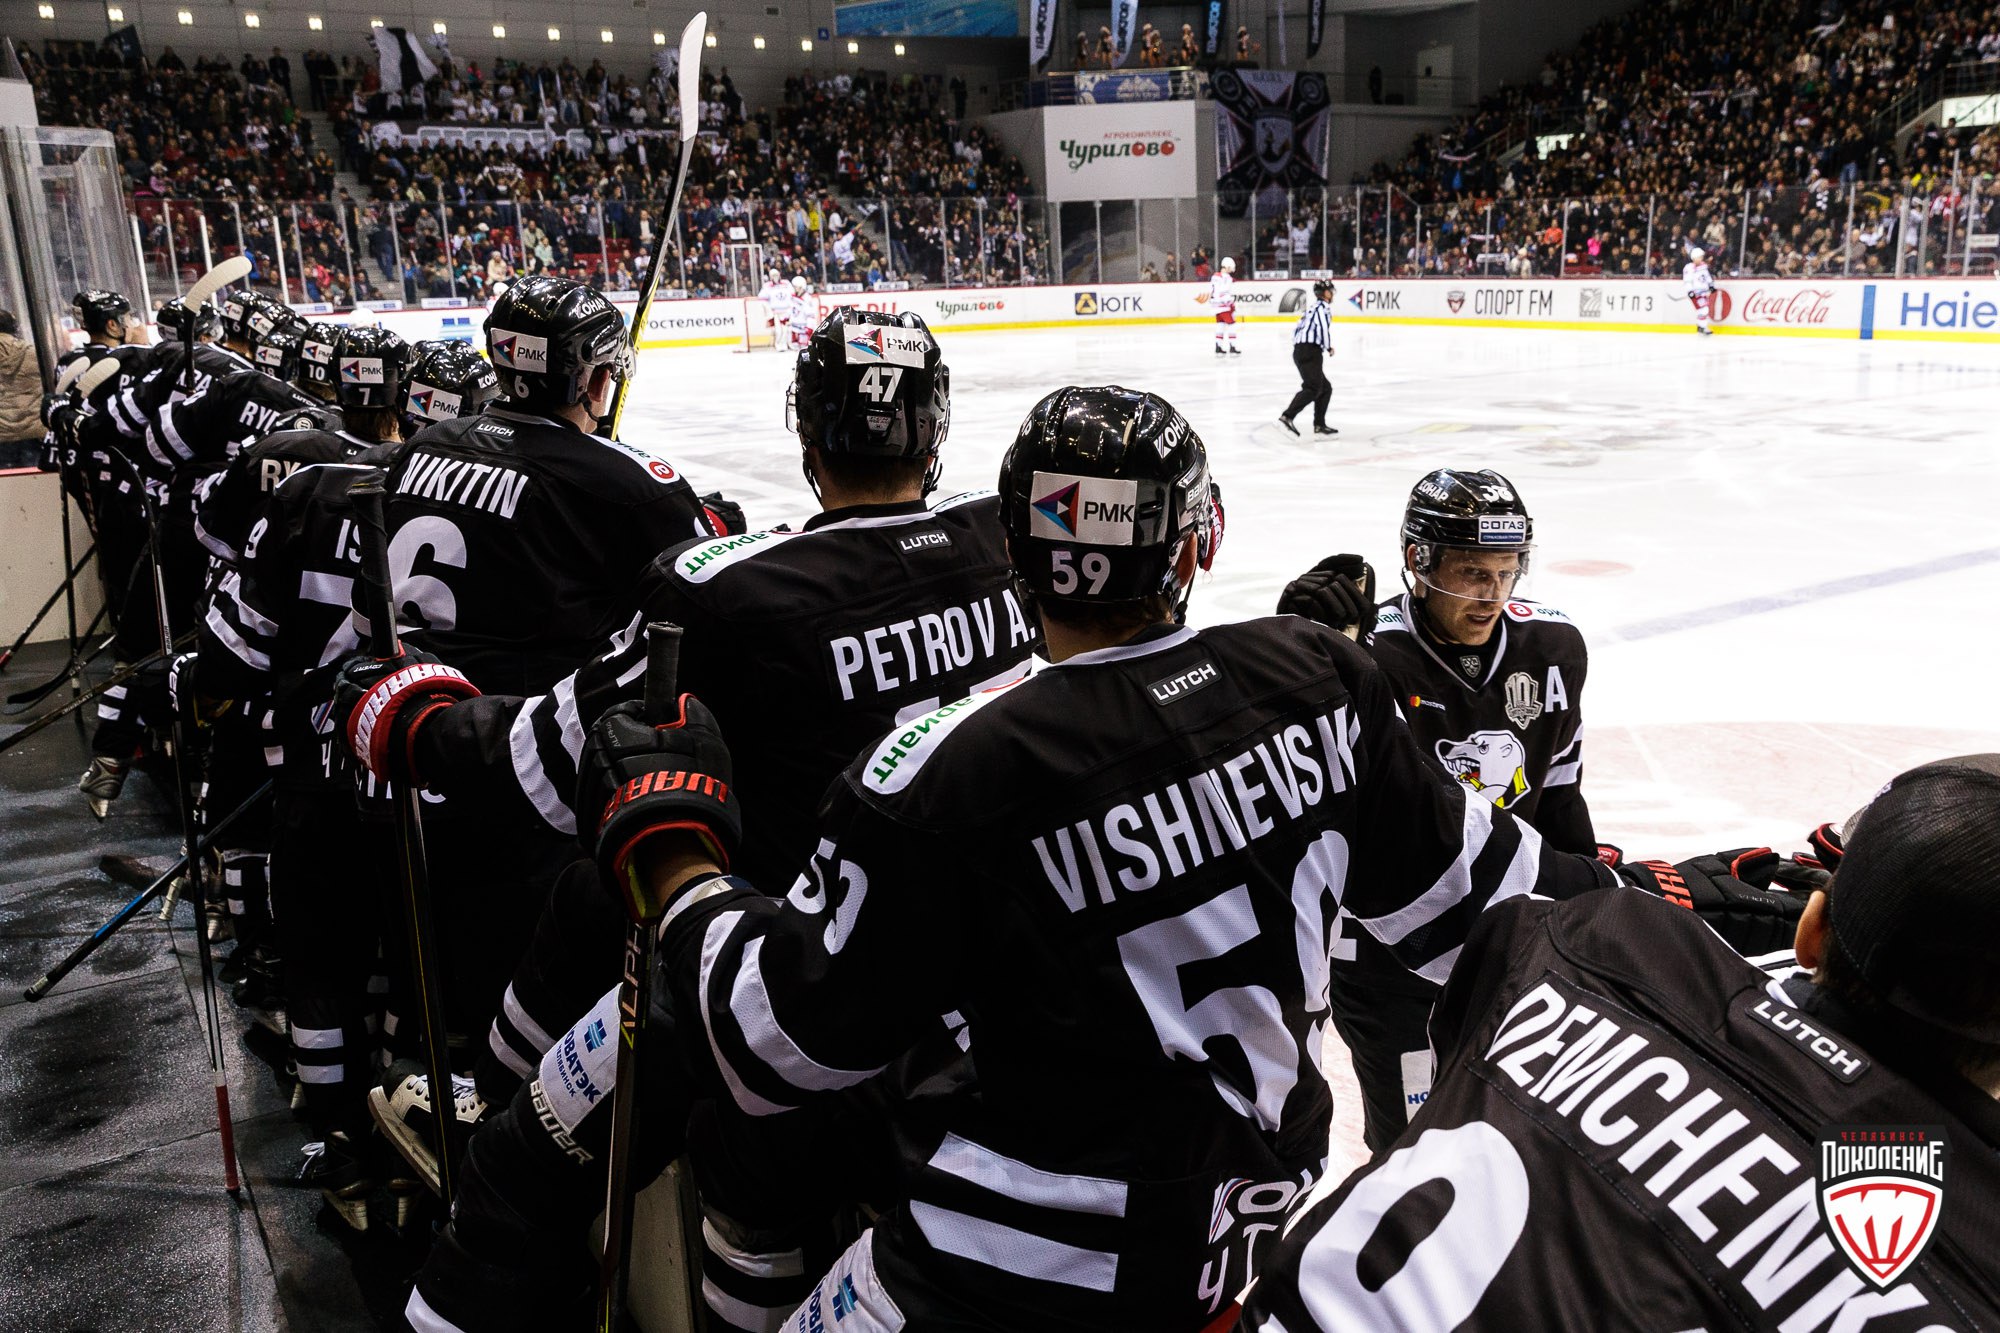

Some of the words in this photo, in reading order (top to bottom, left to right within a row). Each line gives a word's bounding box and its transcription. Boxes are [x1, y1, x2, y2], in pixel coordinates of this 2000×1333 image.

[1103, 129, 1173, 140] АГРОКОМПЛЕКС
[1059, 139, 1176, 172] Чурилово
[935, 300, 1005, 319] Чурилово
[1101, 295, 1143, 313] ЮГК
[1366, 291, 1401, 311] РМК
[1475, 289, 1525, 315] СПОРТ
[1528, 289, 1553, 316] FM
[646, 316, 735, 331] остелеком
[516, 346, 547, 363] РМК
[308, 364, 326, 381] 10
[361, 366, 382, 376] РМК
[514, 374, 530, 399] 6
[858, 365, 904, 403] 47
[358, 387, 371, 406] 7
[432, 400, 459, 415] РМК
[477, 422, 514, 437] LUTCH
[397, 452, 528, 519] NIKITIN
[1083, 501, 1135, 523] РМК
[1480, 520, 1525, 530] СОГАЗ
[900, 531, 949, 551] LUTCH
[387, 515, 467, 633] 6
[1051, 550, 1111, 595] 59
[829, 597, 995, 701] PETROV
[1002, 588, 1037, 649] A.
[1151, 662, 1217, 701] LUTCH
[1544, 665, 1569, 713] A
[873, 697, 975, 785] ариант
[1753, 1000, 1862, 1076] LUTCH
[530, 1080, 595, 1166] BAUER
[1484, 982, 1960, 1333] DEMCHENK
